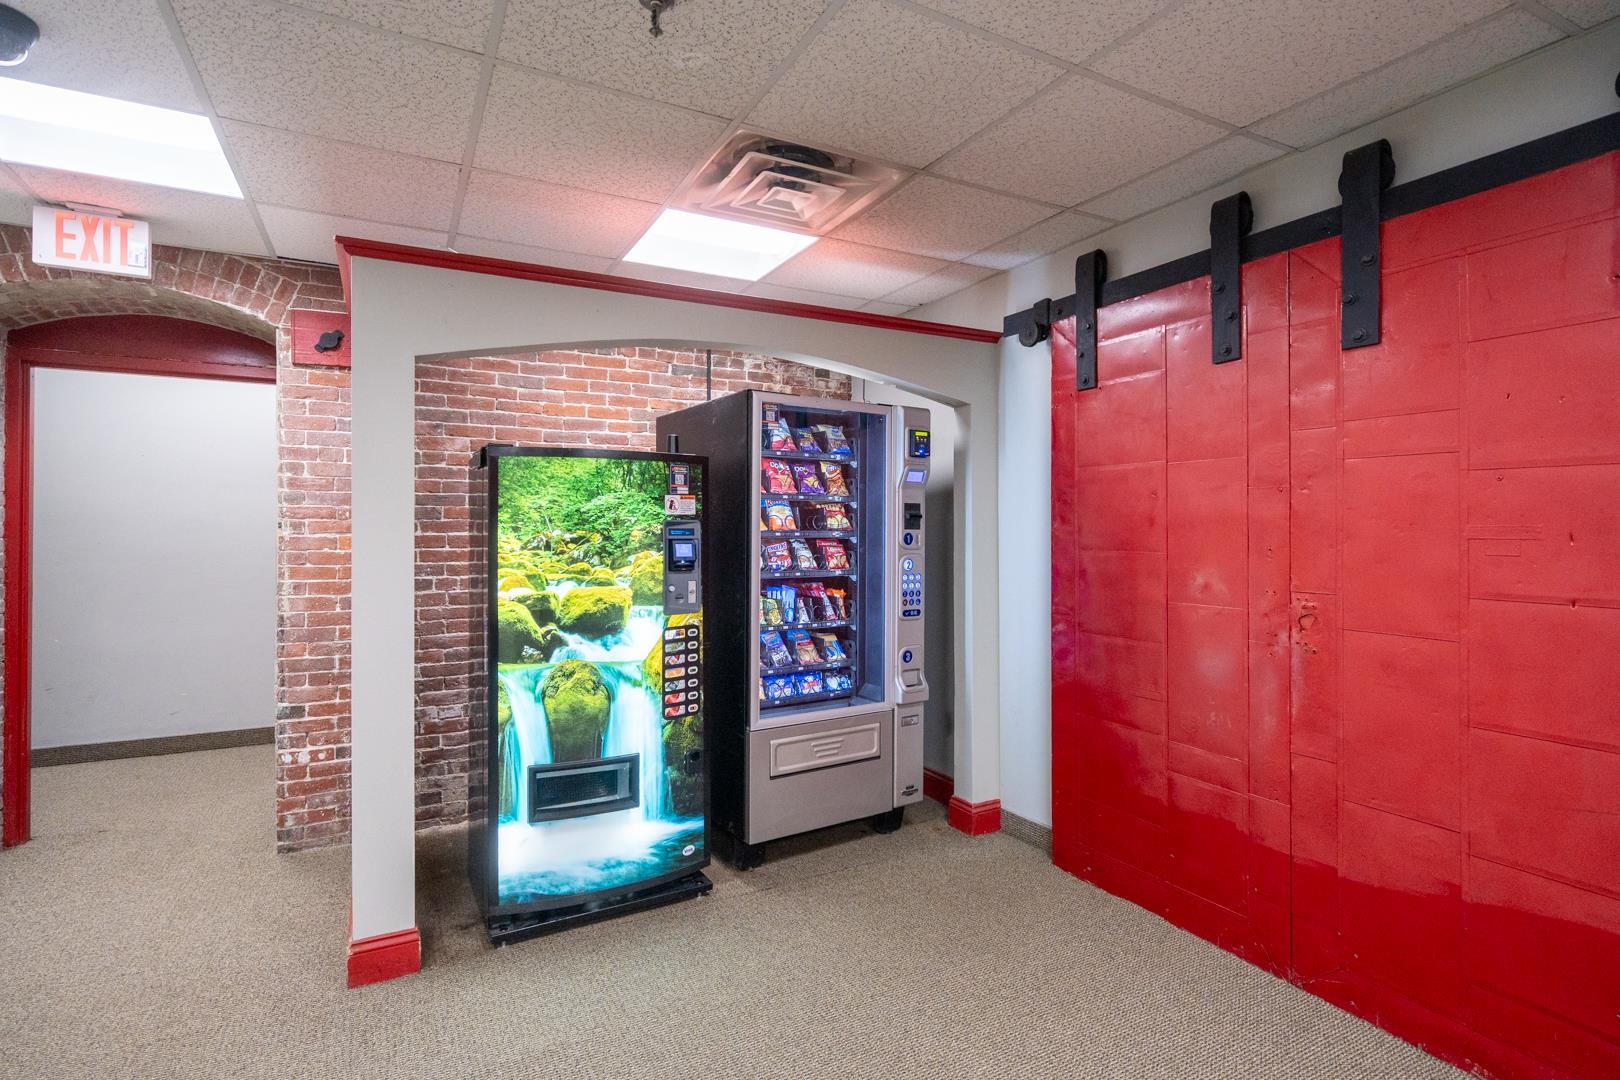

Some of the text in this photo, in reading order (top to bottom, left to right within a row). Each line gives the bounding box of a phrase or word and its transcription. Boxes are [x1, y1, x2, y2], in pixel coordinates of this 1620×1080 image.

[54, 211, 134, 266] EXIT
[906, 535, 910, 544] 1
[906, 561, 911, 569] 2
[905, 652, 910, 661] 3
